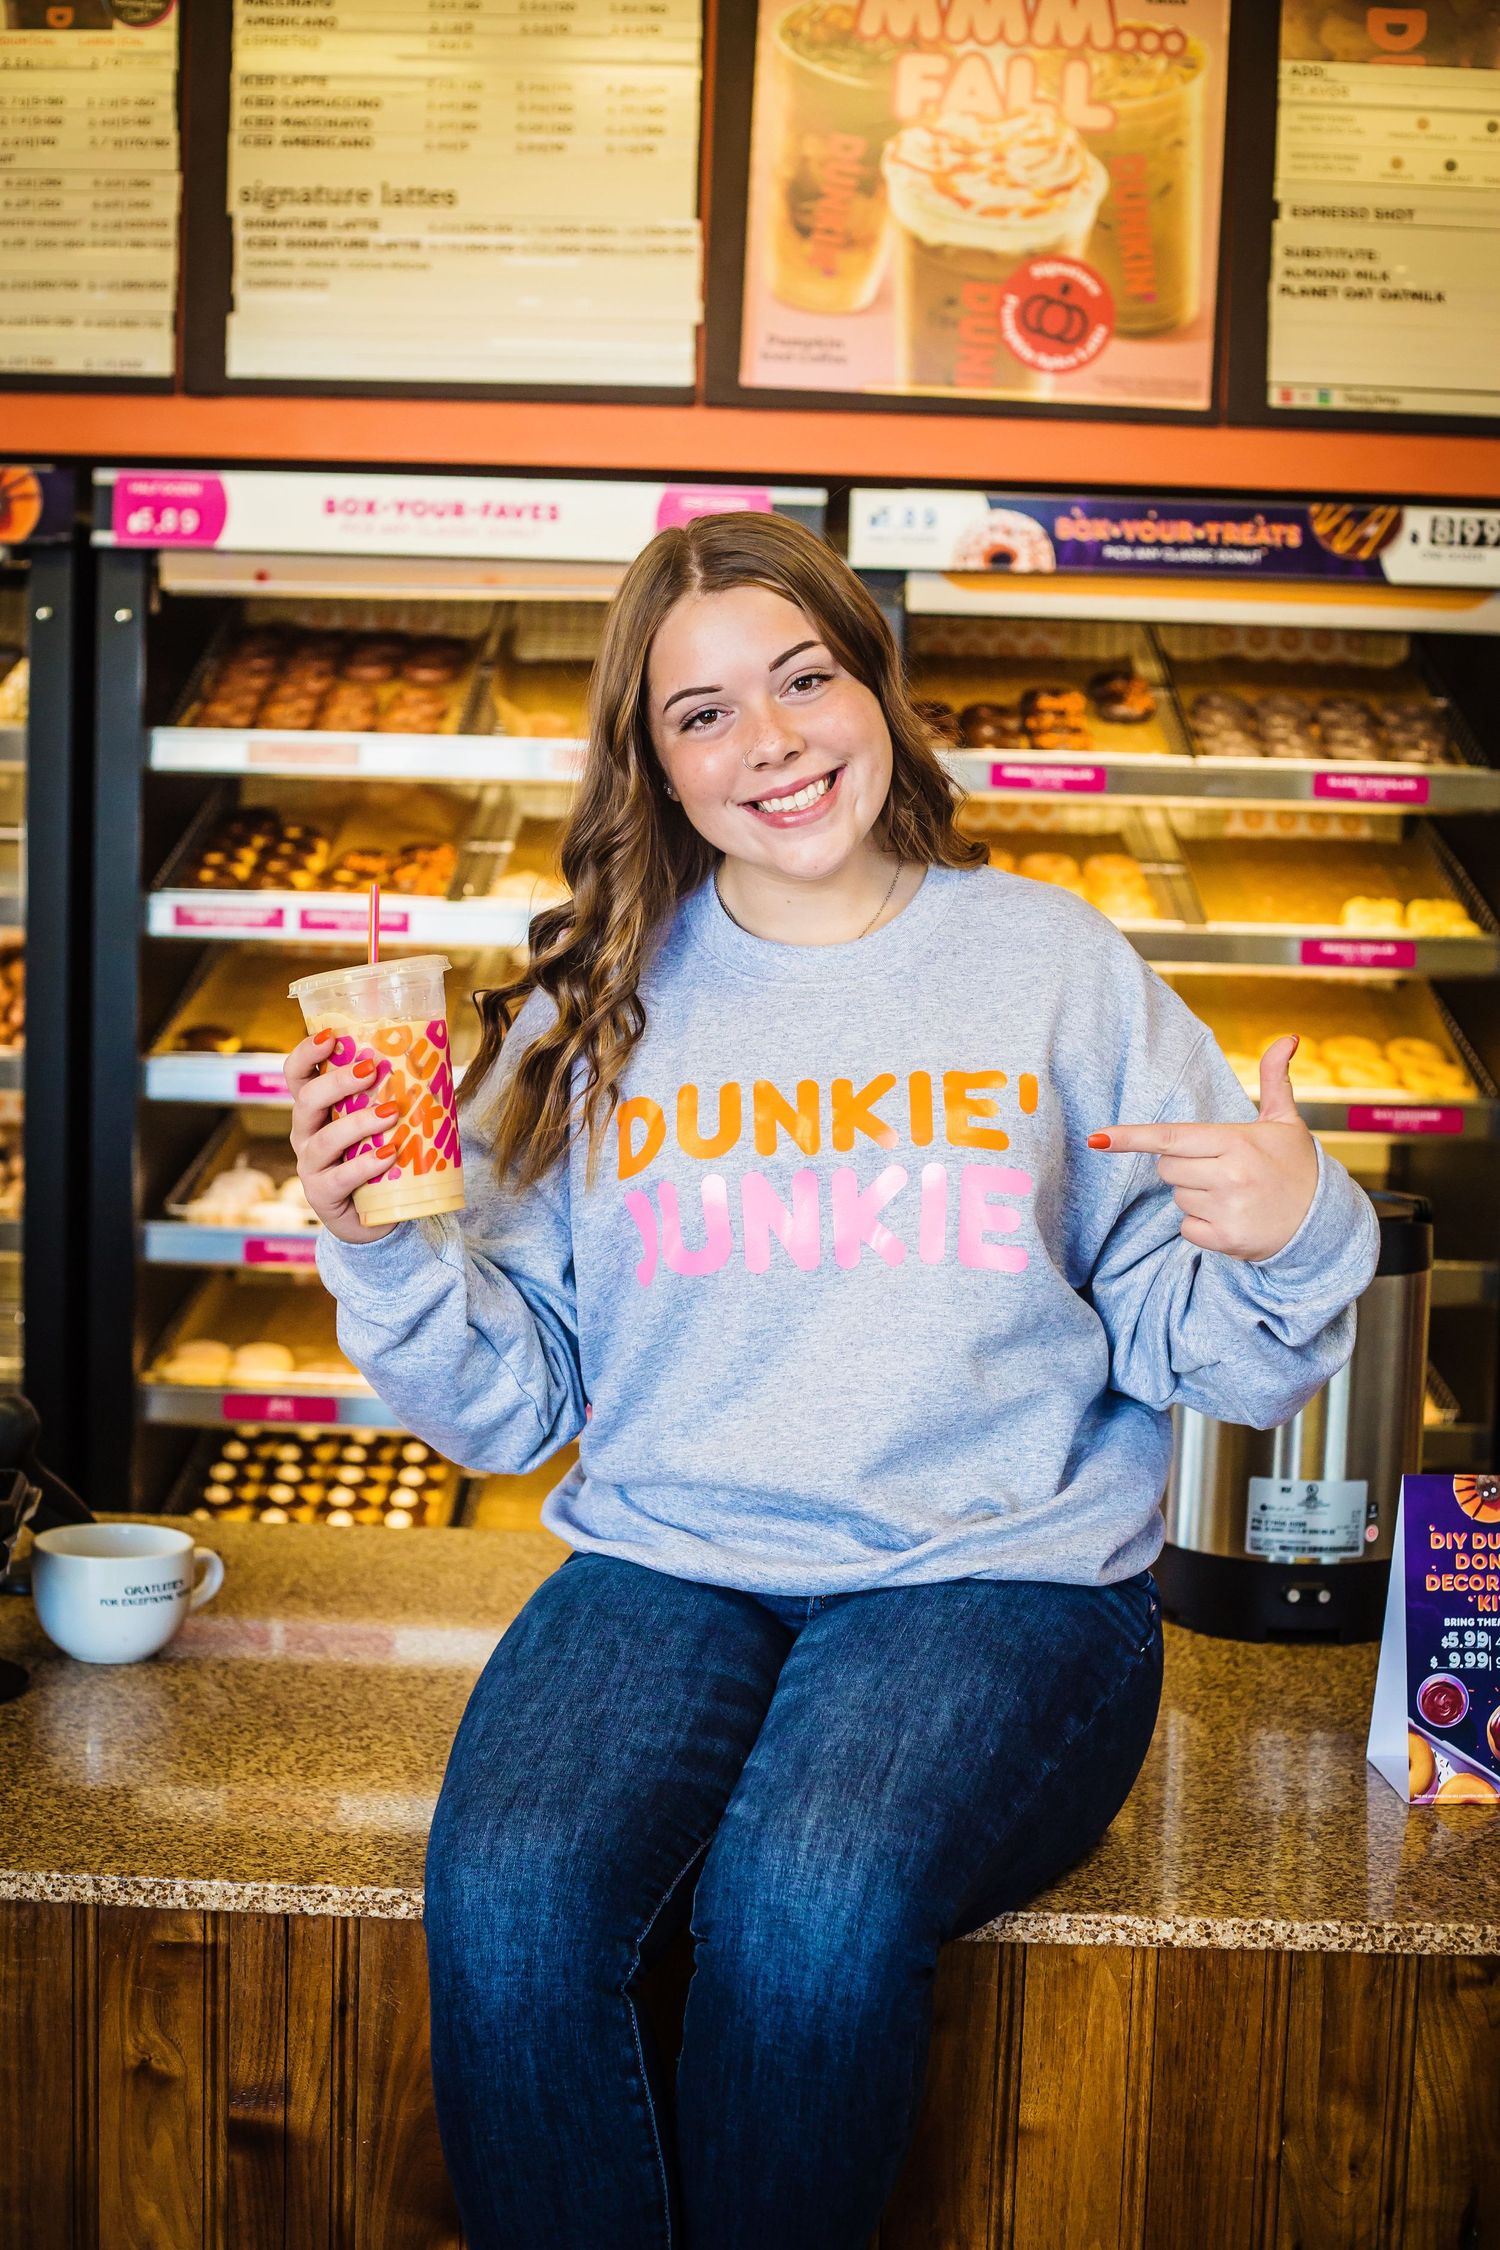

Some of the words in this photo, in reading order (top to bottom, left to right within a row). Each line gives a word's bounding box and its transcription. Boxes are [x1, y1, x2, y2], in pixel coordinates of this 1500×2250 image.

[897, 52, 1118, 130] FALL
[239, 179, 373, 212] signature
[381, 179, 457, 207] lattes
[1291, 205, 1369, 219] ESPRESSO
[1375, 207, 1415, 221] SHOT
[1279, 284, 1338, 299] PLANET
[1343, 286, 1374, 300] OAT
[1379, 288, 1447, 304] OATMILK
[617, 1070, 1039, 1181] DUNKIE'
[1430, 1532, 1468, 1550] DIY
[1444, 1617, 1475, 1627] BRING
